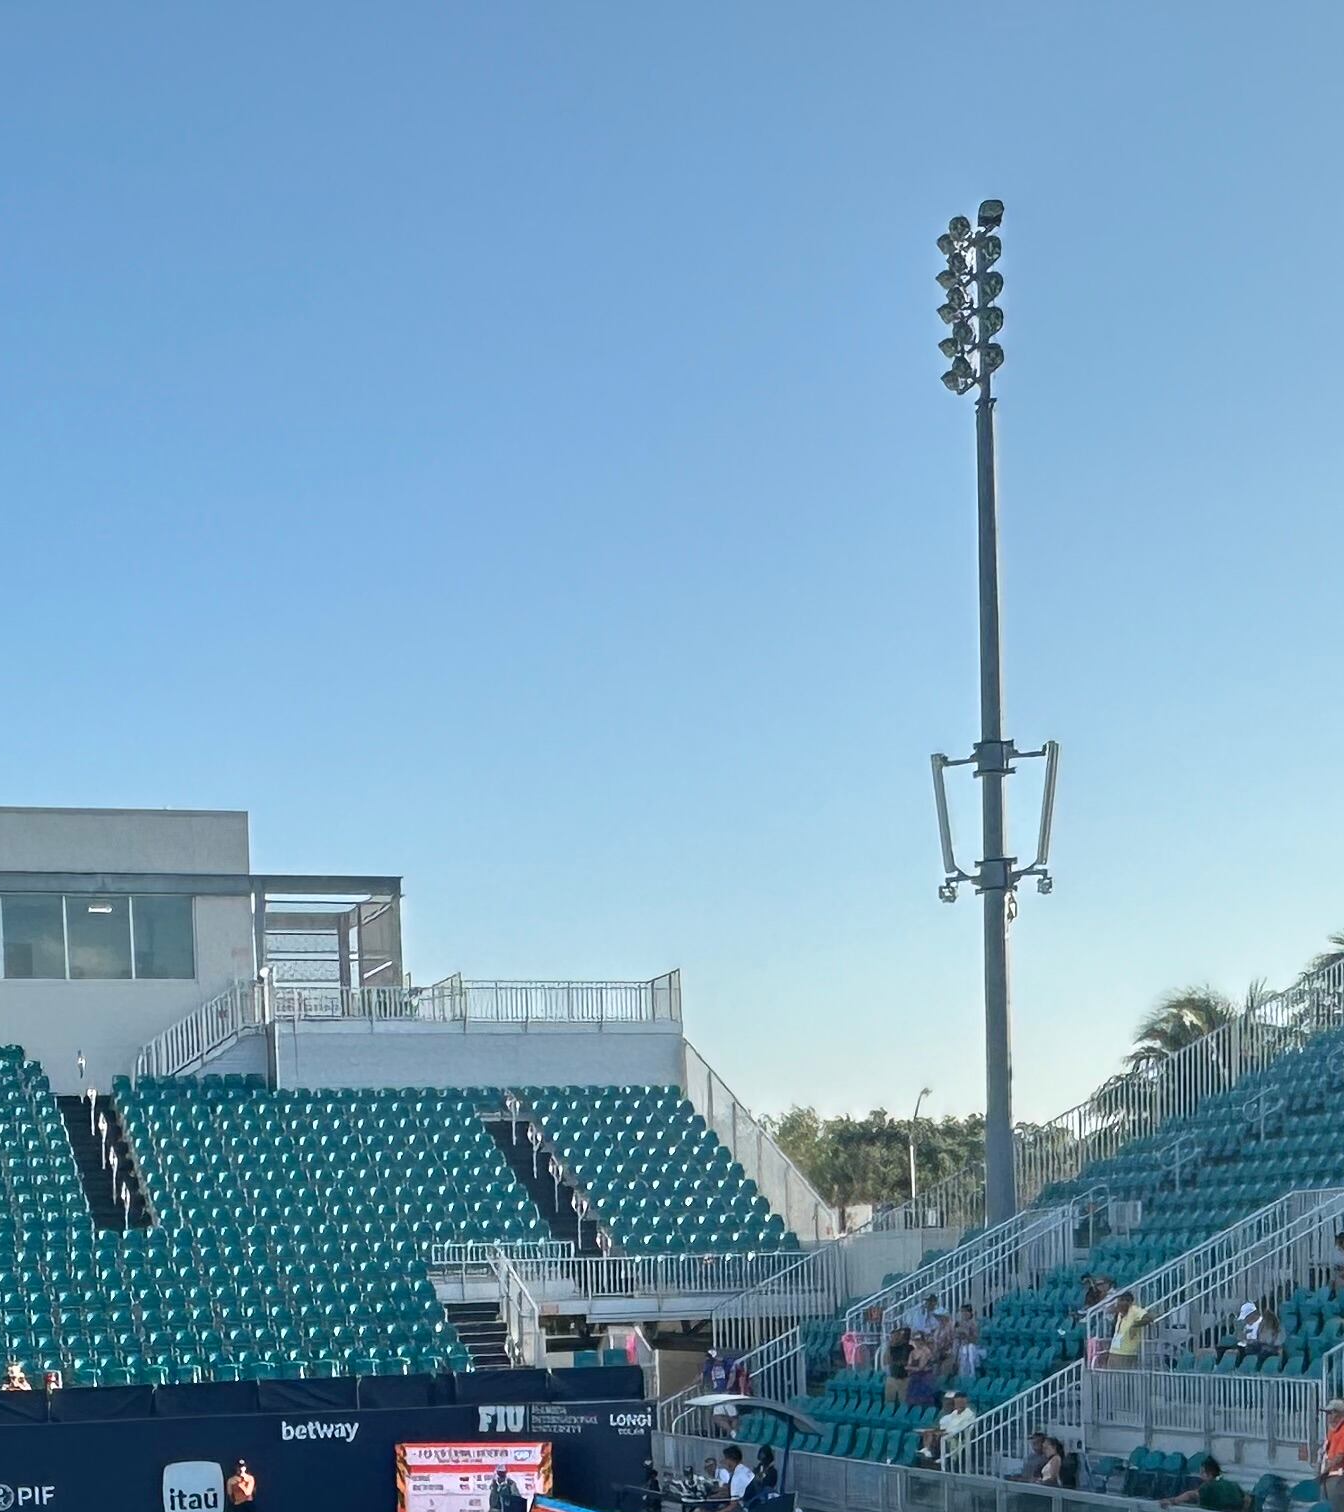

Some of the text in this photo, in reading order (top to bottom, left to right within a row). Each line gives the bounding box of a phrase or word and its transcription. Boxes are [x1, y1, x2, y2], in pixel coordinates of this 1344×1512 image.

[478, 1405, 525, 1432] FIU
[282, 1420, 359, 1442] betway
[17, 1486, 55, 1506] PIF
